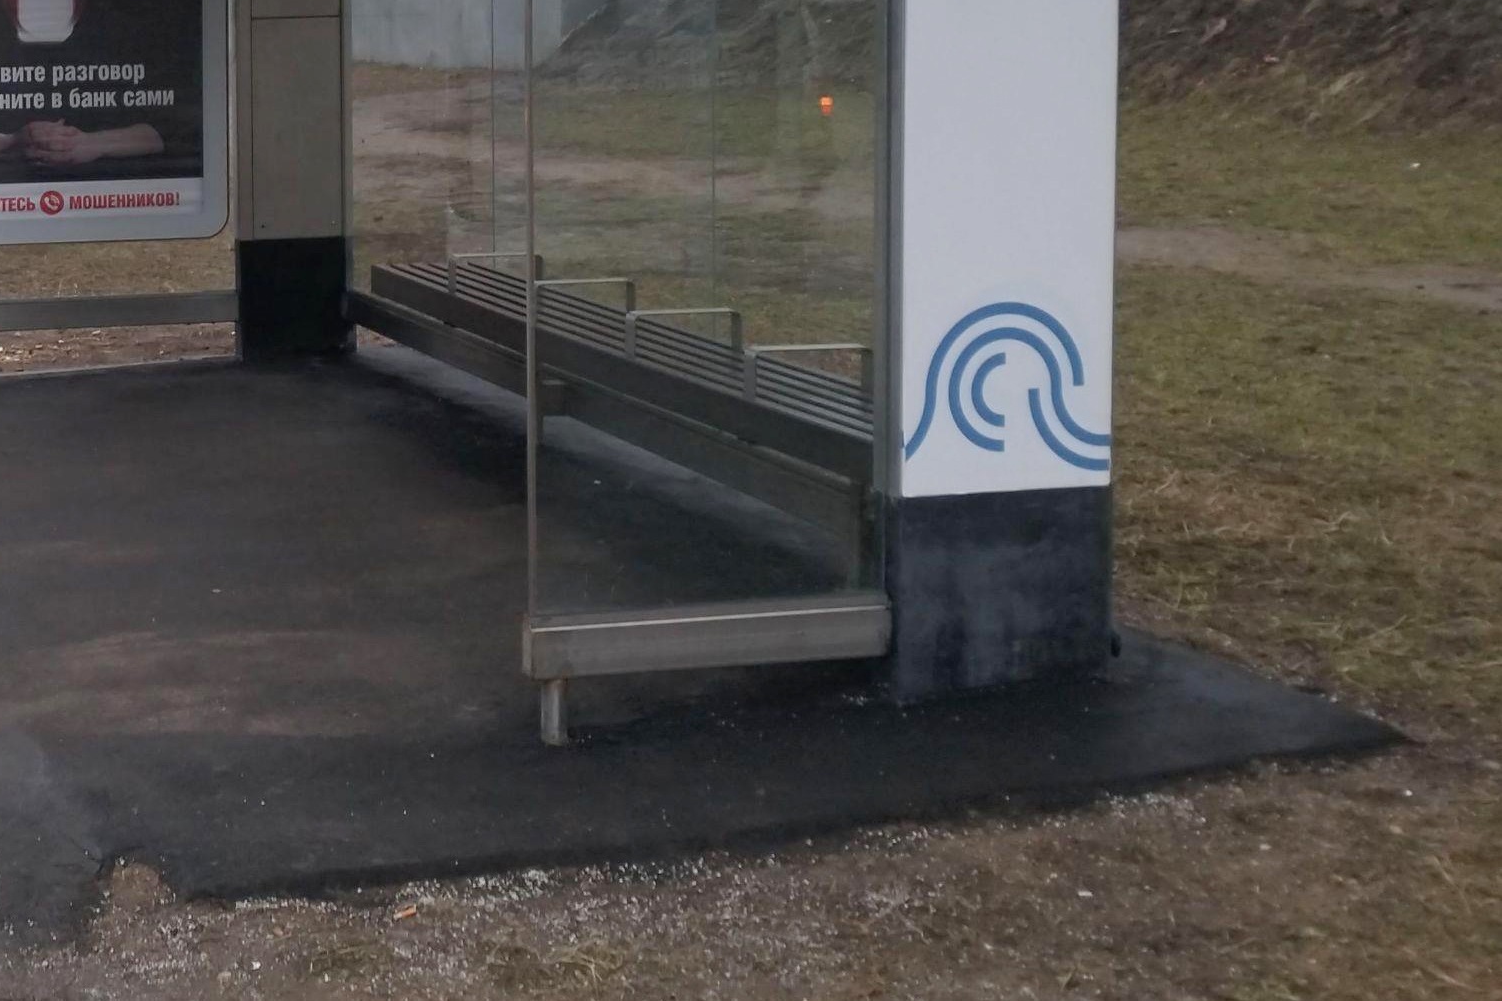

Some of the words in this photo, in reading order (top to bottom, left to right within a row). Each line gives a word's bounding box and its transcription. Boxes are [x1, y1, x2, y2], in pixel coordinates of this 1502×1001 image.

[52, 63, 146, 86] разговор
[51, 91, 63, 109] в
[69, 87, 117, 108] банк
[123, 89, 175, 107] сами
[69, 191, 180, 210] МОШЕННИКОВ!
